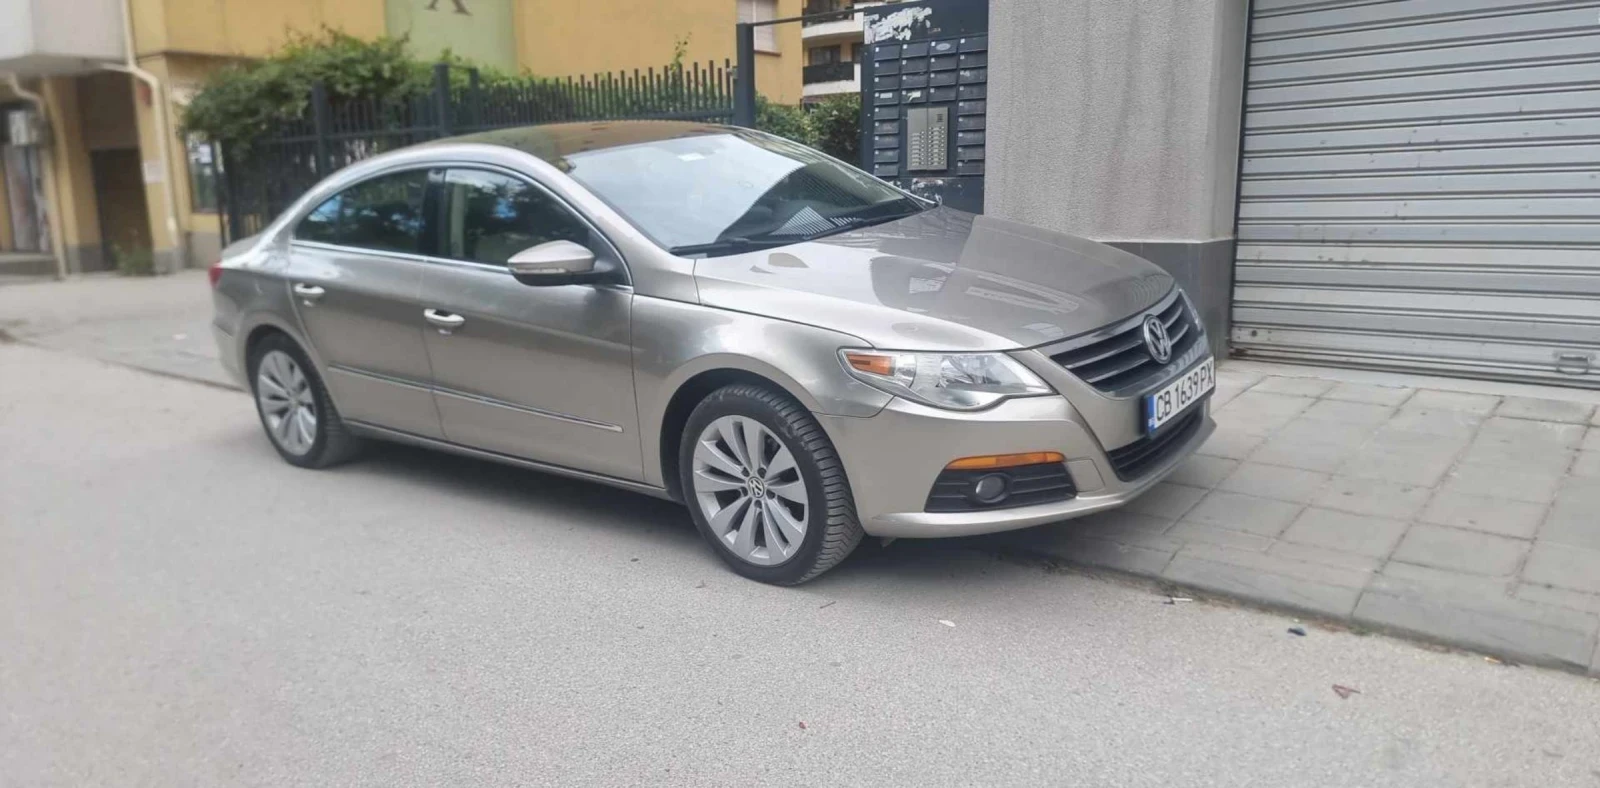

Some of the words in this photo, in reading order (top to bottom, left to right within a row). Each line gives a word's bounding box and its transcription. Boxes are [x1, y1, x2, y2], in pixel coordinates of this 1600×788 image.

[1144, 316, 1171, 363] VW
[1156, 390, 1172, 421] CB
[1175, 372, 1199, 409] 1639
[1200, 360, 1214, 391] PX
